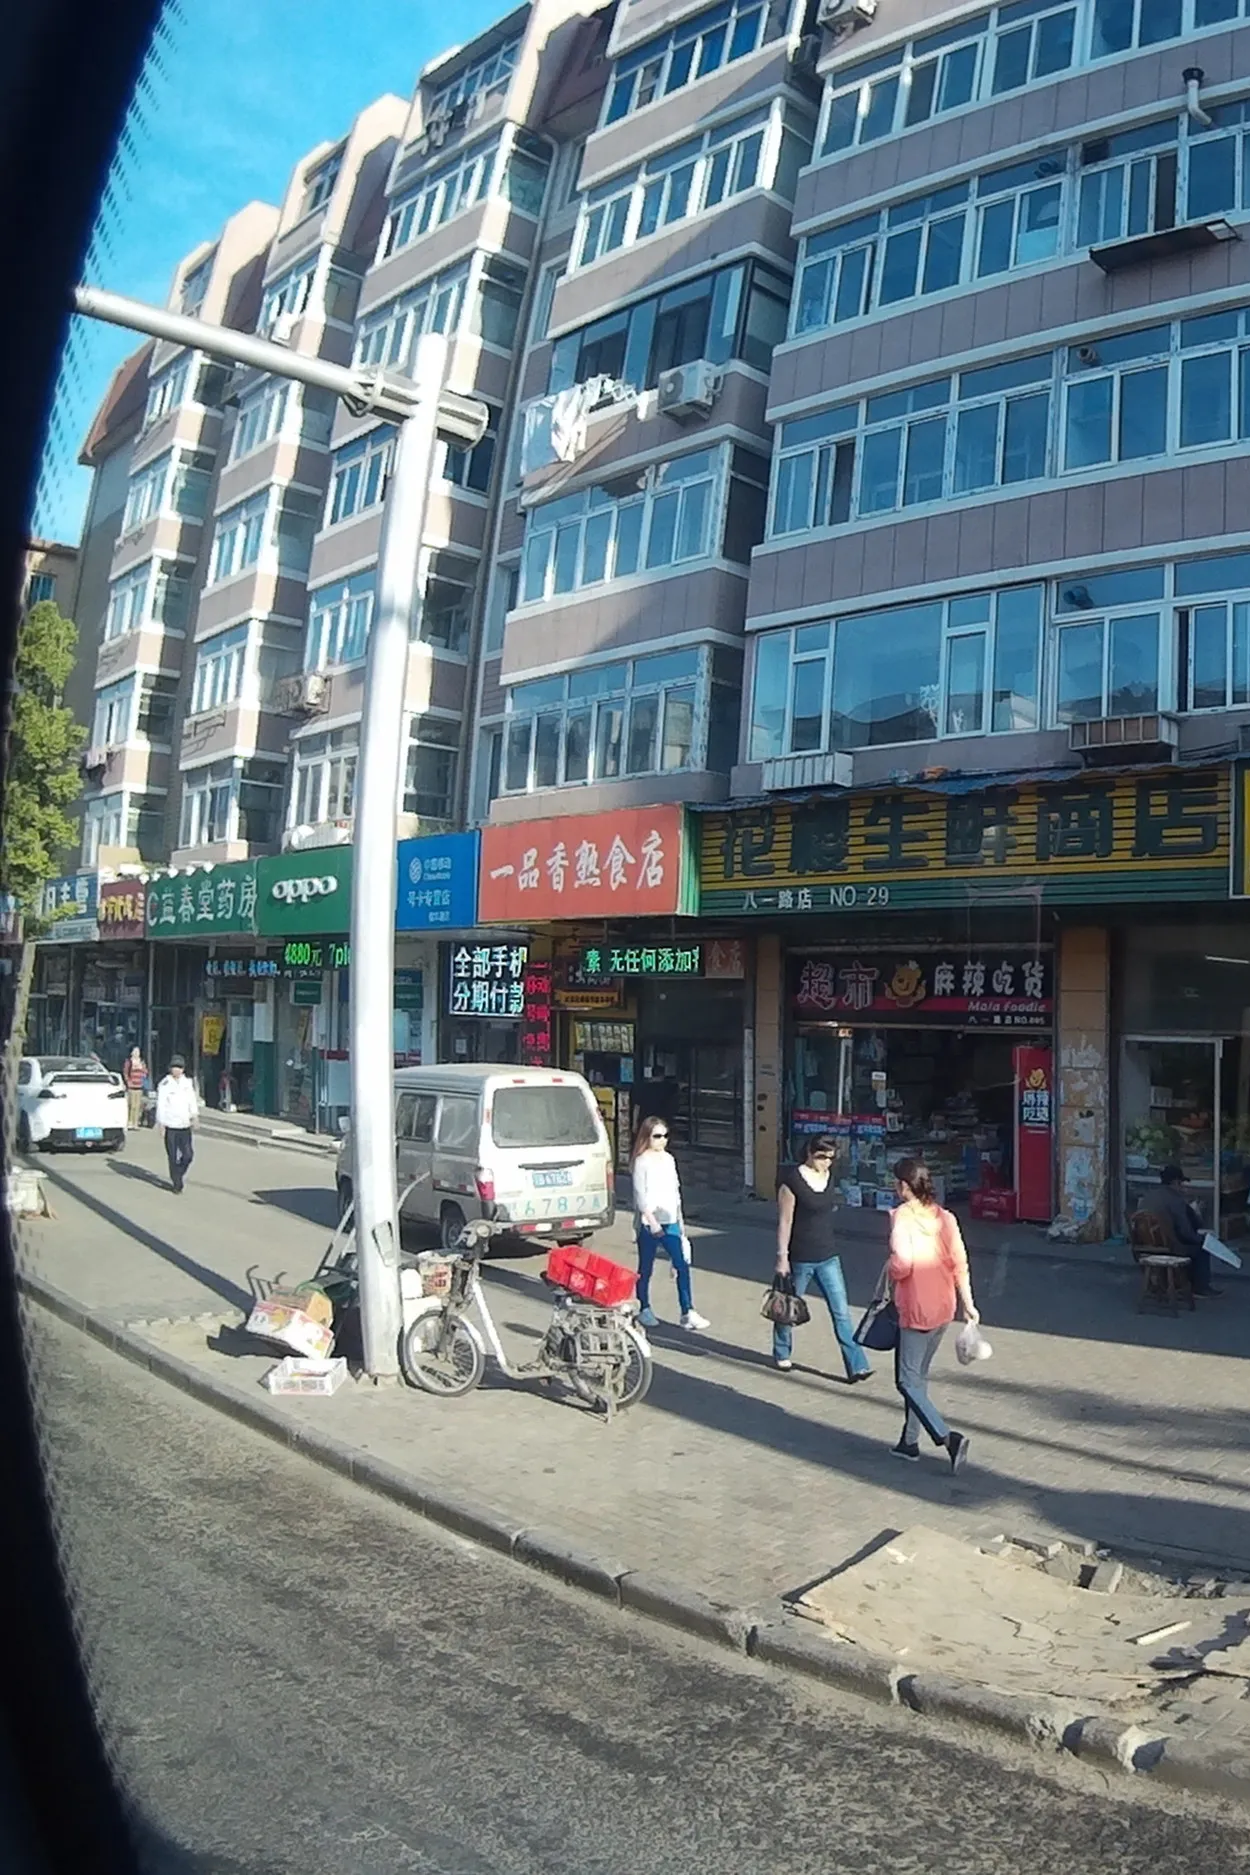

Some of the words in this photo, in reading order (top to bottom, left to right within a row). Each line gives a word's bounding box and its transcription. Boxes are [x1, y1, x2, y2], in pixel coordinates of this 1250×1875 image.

[489, 829, 665, 893] 一品香熟食店
[743, 889, 812, 910] 八一路店
[933, 959, 1045, 998] 麻辣吃货
